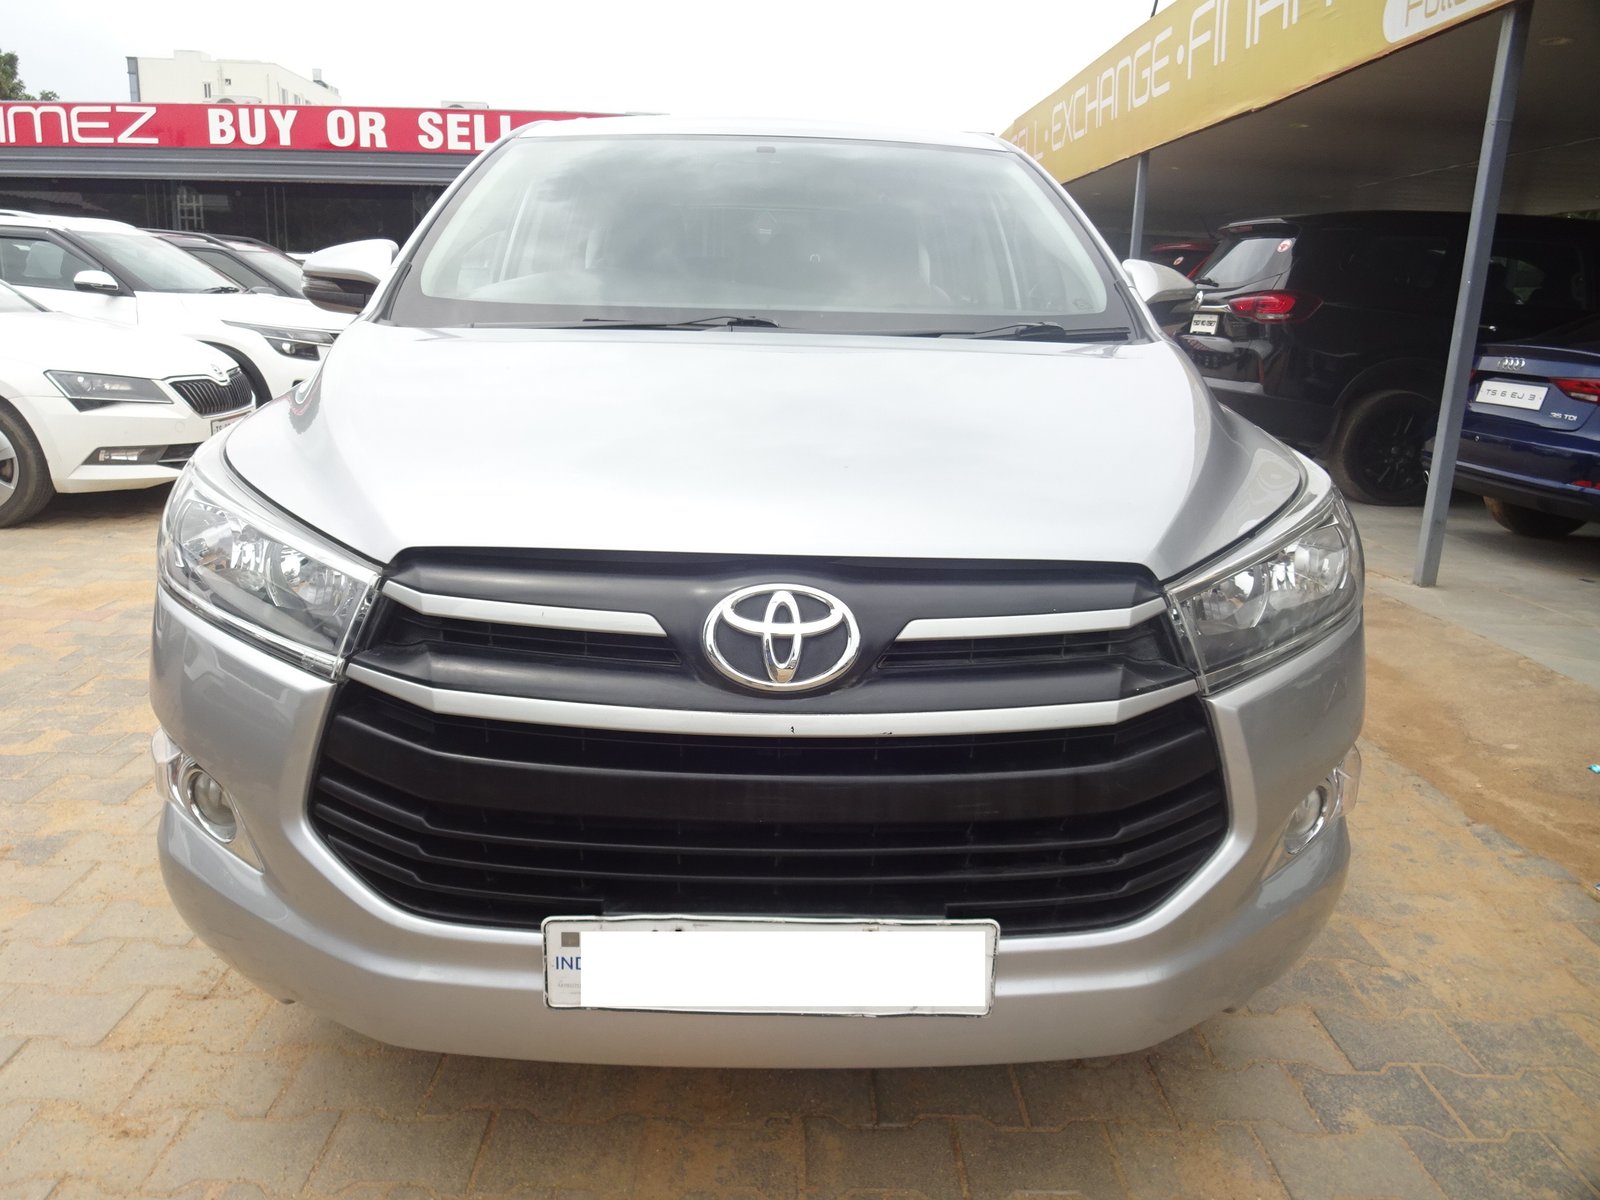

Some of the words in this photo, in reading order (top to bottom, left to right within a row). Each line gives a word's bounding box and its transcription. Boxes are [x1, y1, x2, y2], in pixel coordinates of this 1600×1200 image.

[1052, 26, 1173, 152] EXCHANGE
[207, 108, 298, 146] BUY
[326, 109, 388, 148] OR
[1486, 388, 1497, 396] TS
[1500, 390, 1507, 398] 6
[1510, 391, 1524, 399] EJ
[1528, 393, 1537, 401] 3
[1564, 413, 1578, 421] TDI
